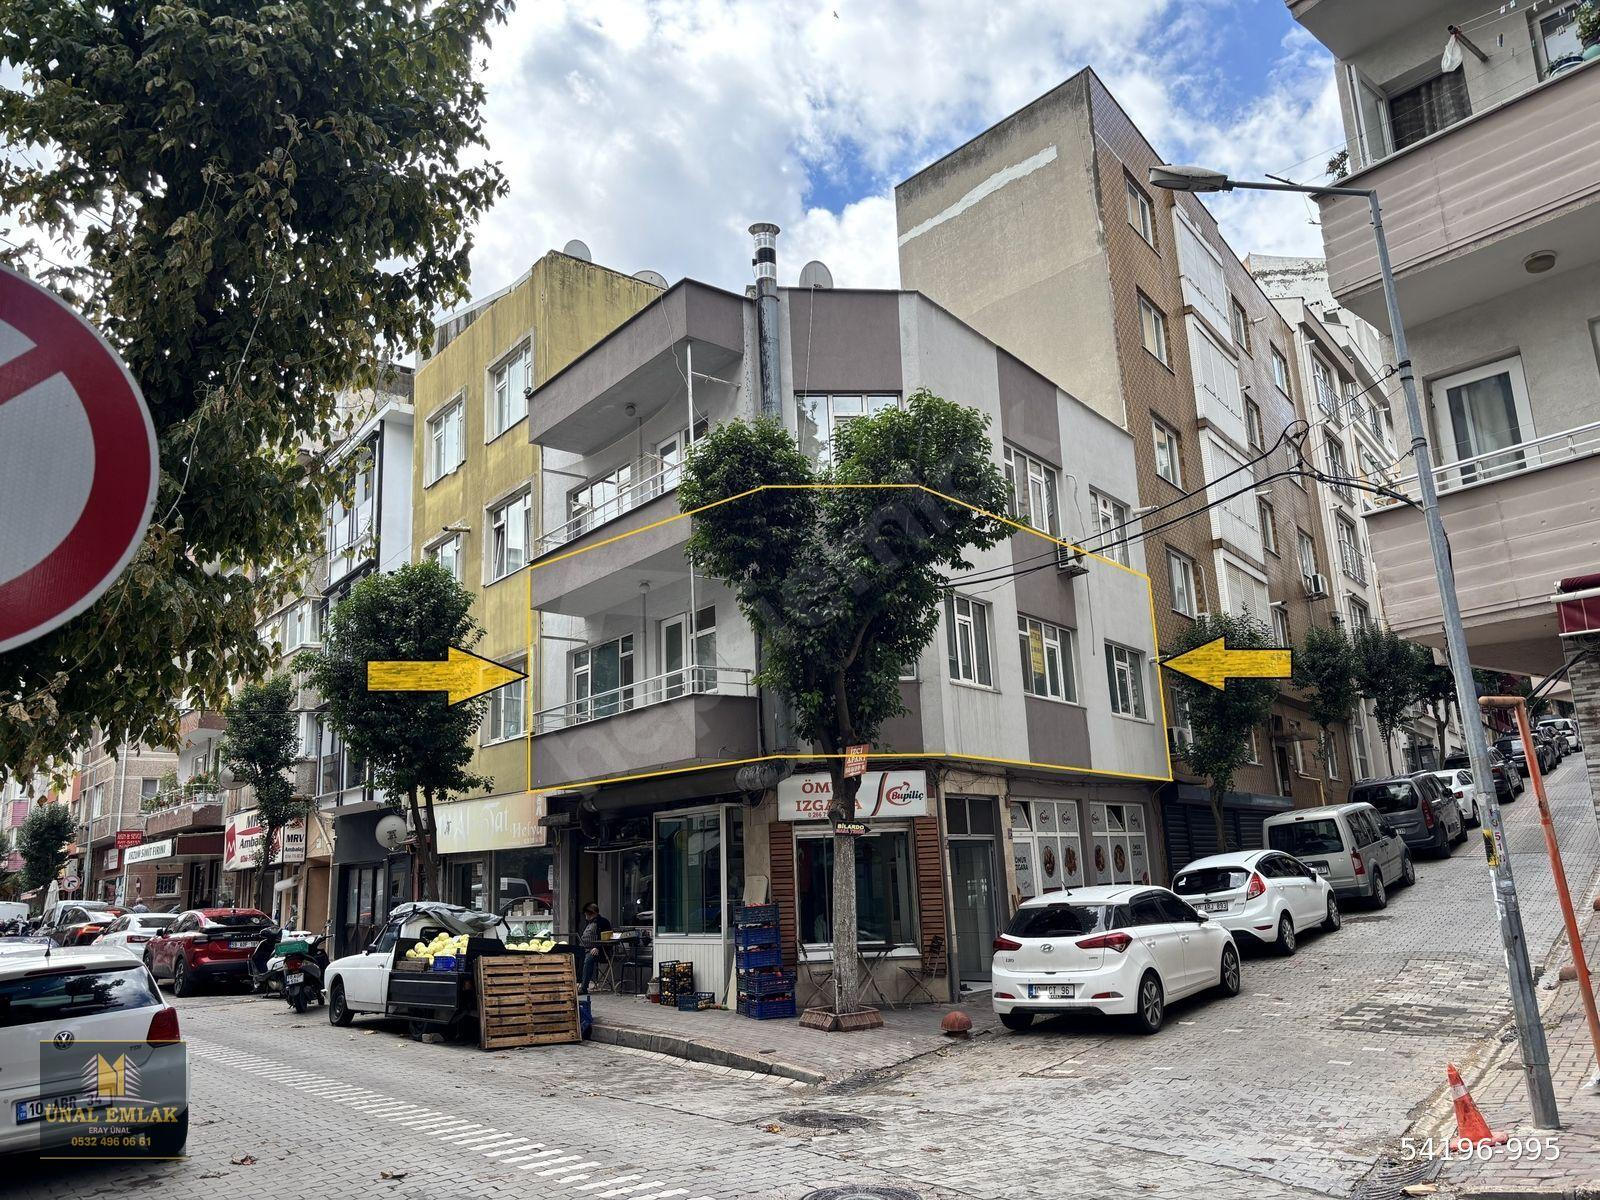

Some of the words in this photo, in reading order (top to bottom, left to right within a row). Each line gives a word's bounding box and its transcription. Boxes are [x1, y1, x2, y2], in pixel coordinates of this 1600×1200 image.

[796, 800, 862, 812] IZGAA
[837, 822, 865, 830] BİLARDO
[286, 834, 304, 842] MRV
[1061, 986, 1070, 994] 96
[29, 1102, 44, 1116] 10
